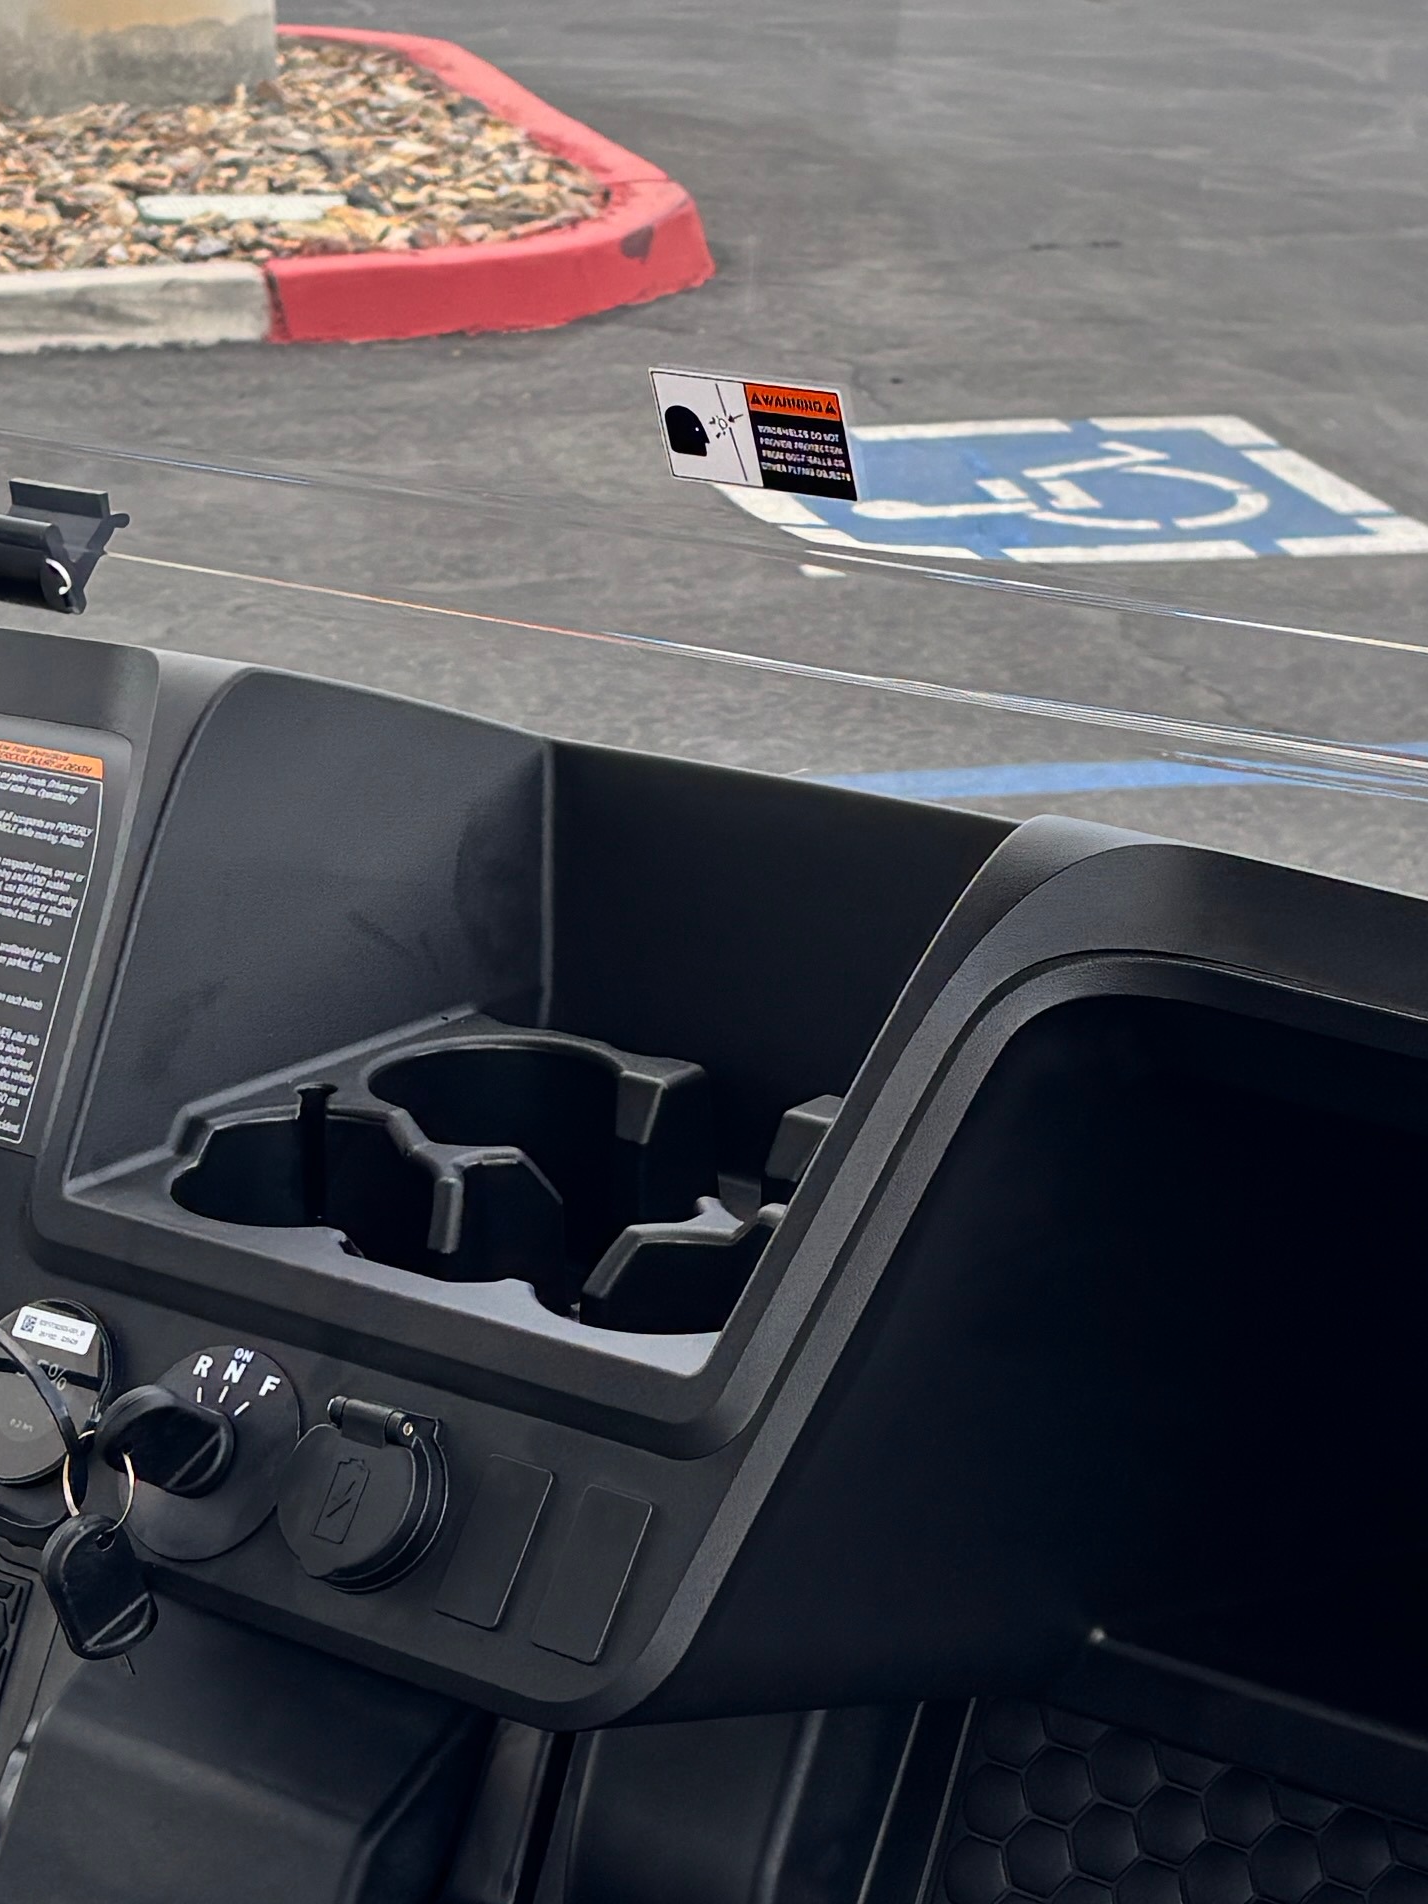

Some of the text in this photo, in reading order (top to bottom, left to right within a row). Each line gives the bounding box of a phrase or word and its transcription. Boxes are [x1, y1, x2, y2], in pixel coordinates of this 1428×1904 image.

[762, 394, 823, 412] WARNING
[234, 1347, 255, 1363] ON
[192, 1354, 280, 1396] R N F
